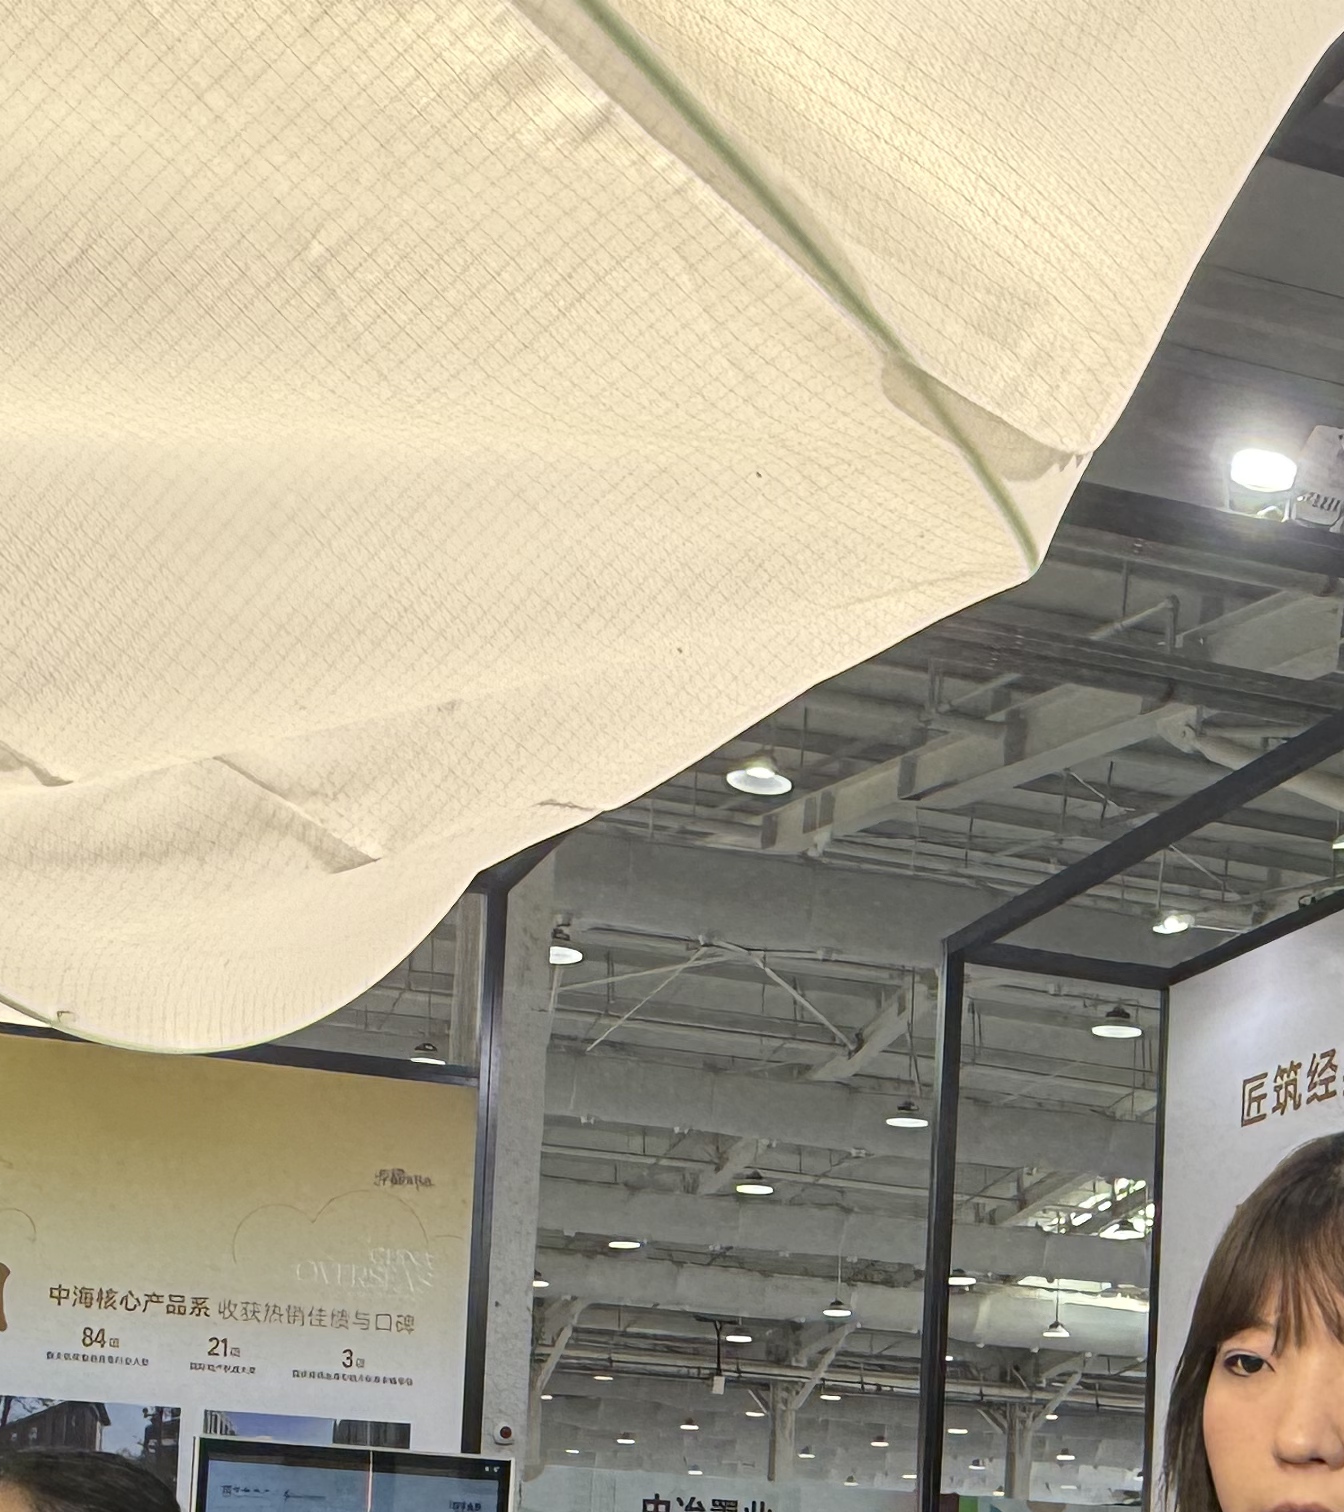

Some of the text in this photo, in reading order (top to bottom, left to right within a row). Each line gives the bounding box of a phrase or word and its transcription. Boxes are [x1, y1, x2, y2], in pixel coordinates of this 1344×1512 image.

[48, 1283, 212, 1318] 中海核心产品系
